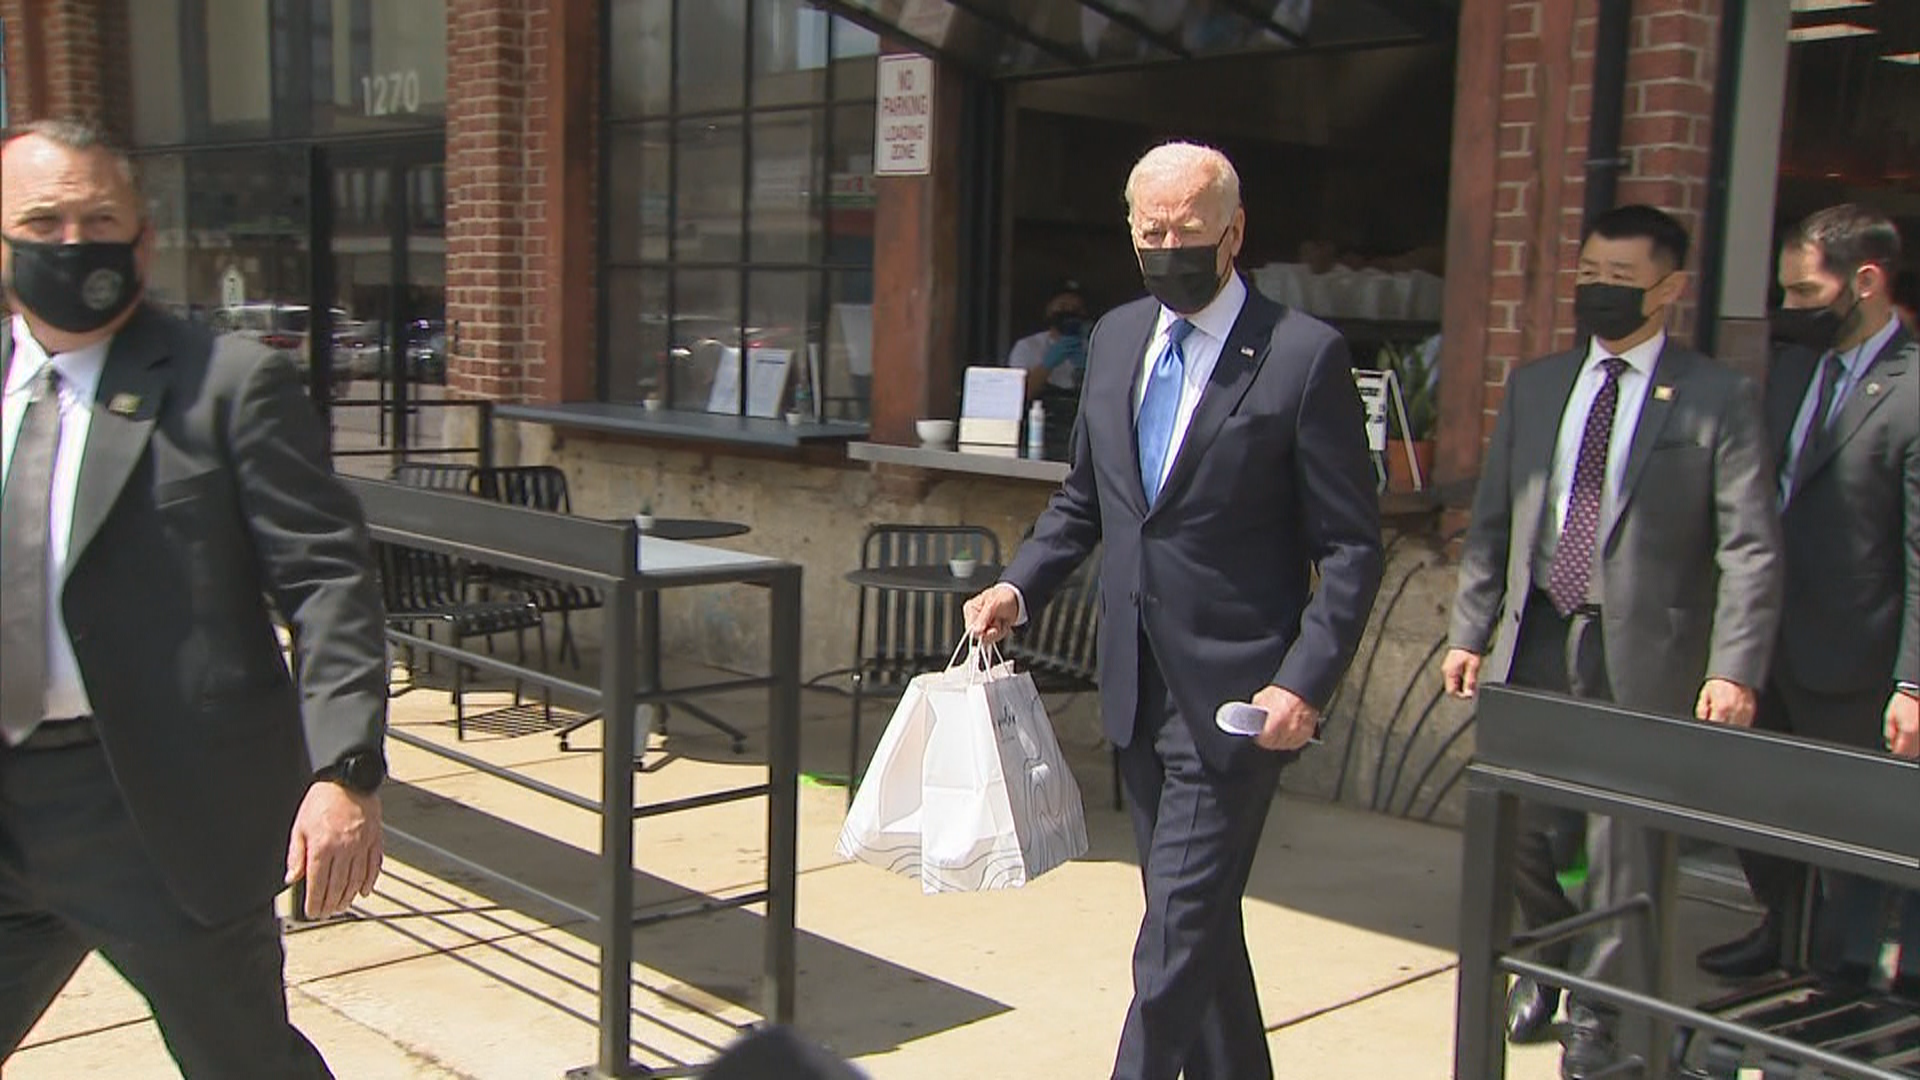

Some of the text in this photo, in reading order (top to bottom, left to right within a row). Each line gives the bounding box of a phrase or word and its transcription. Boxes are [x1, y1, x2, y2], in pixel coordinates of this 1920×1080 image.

[897, 68, 914, 91] NO
[361, 70, 420, 117] 1270
[883, 95, 928, 116] PARKING
[885, 124, 925, 141] LOADING
[891, 143, 916, 160] ZONE
